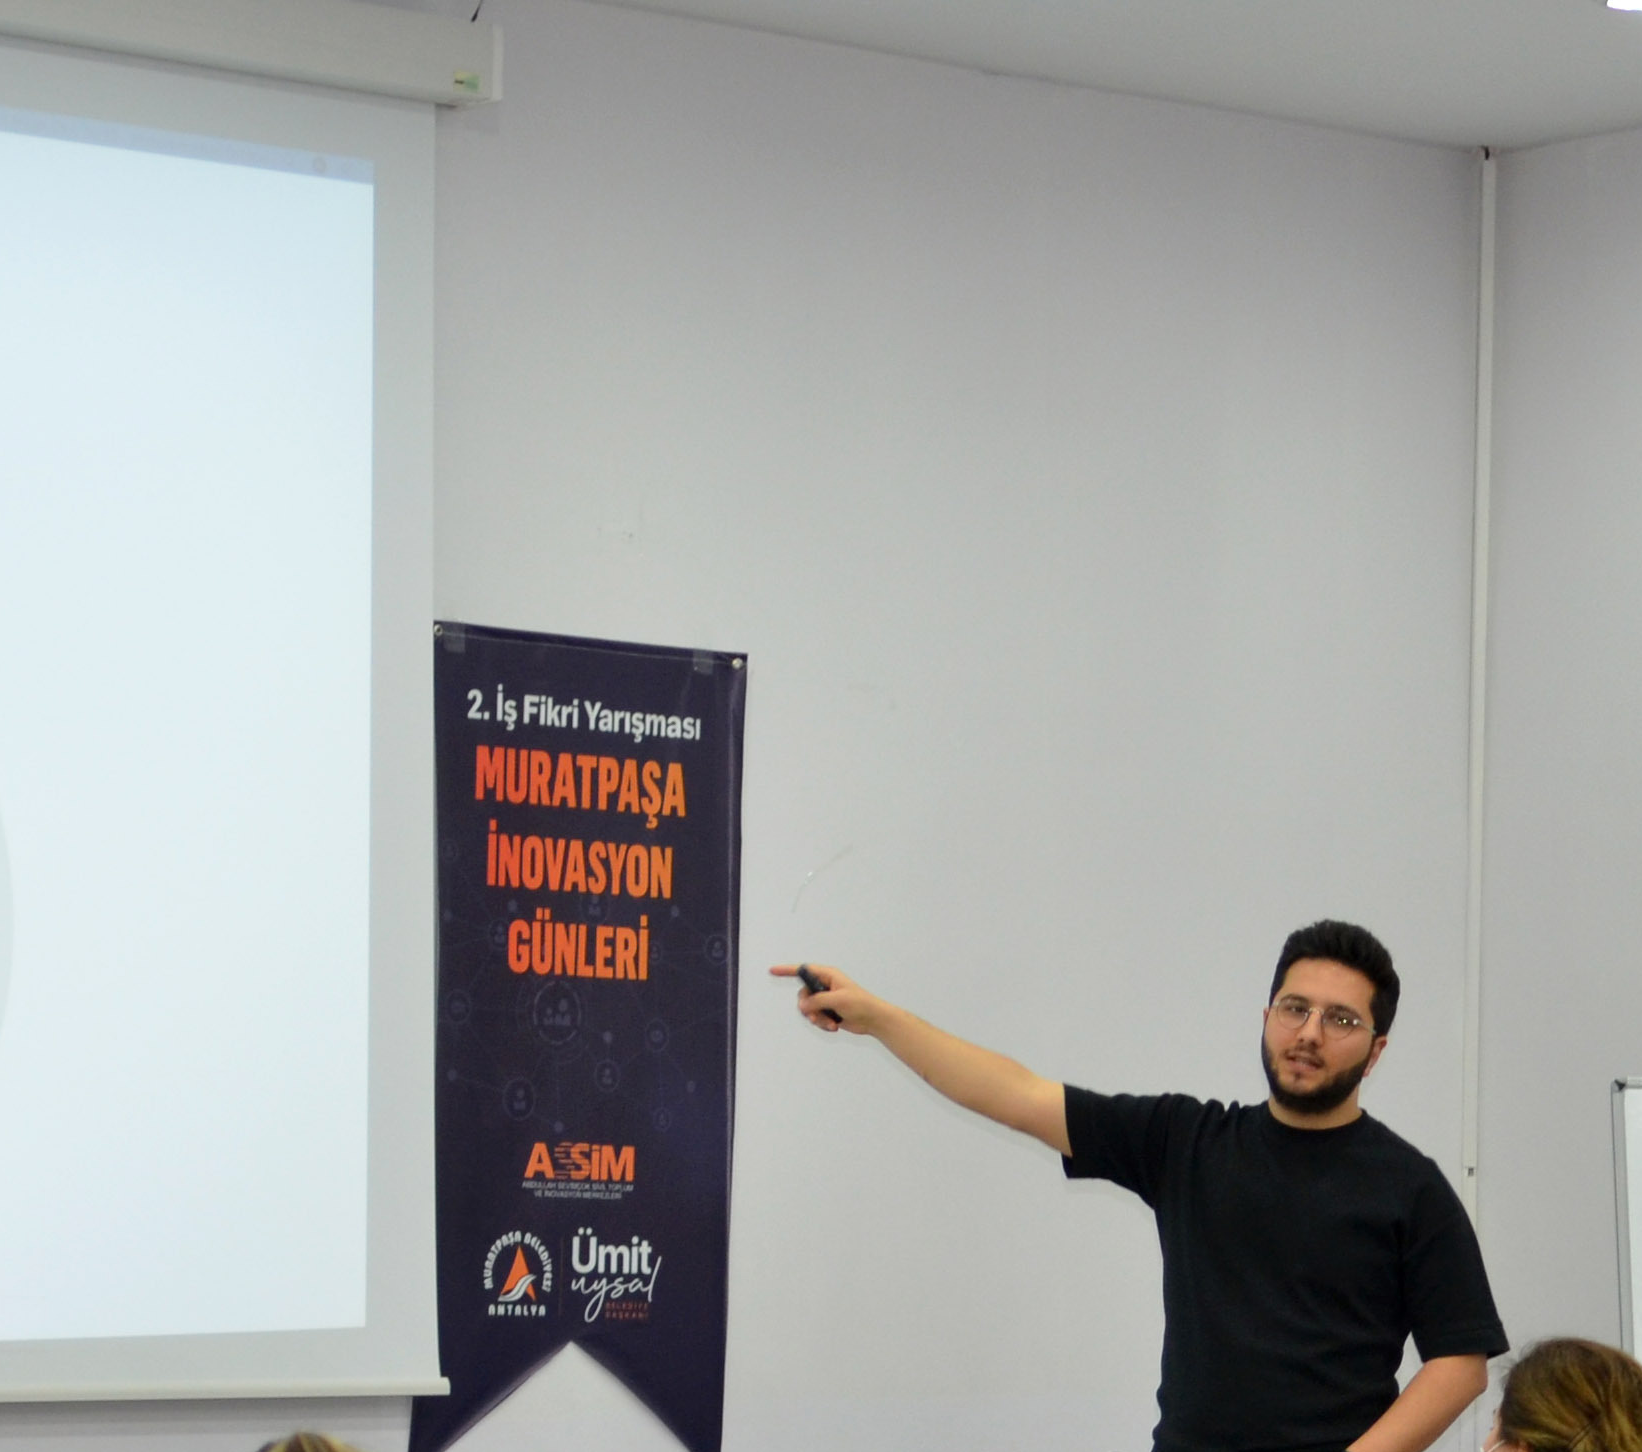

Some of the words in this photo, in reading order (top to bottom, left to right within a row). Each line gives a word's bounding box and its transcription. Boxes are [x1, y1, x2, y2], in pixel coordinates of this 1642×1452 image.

[467, 689, 491, 720] 2.
[496, 683, 517, 731] İş
[522, 694, 579, 729] Fikri
[584, 701, 701, 743] Yarışması
[474, 745, 686, 828] MURATPAŞA
[487, 818, 673, 899] İNOVASYON
[507, 907, 650, 980] GÜNLERİ
[571, 1226, 653, 1276] Ümit
[488, 1303, 546, 1316] ANTALYA
